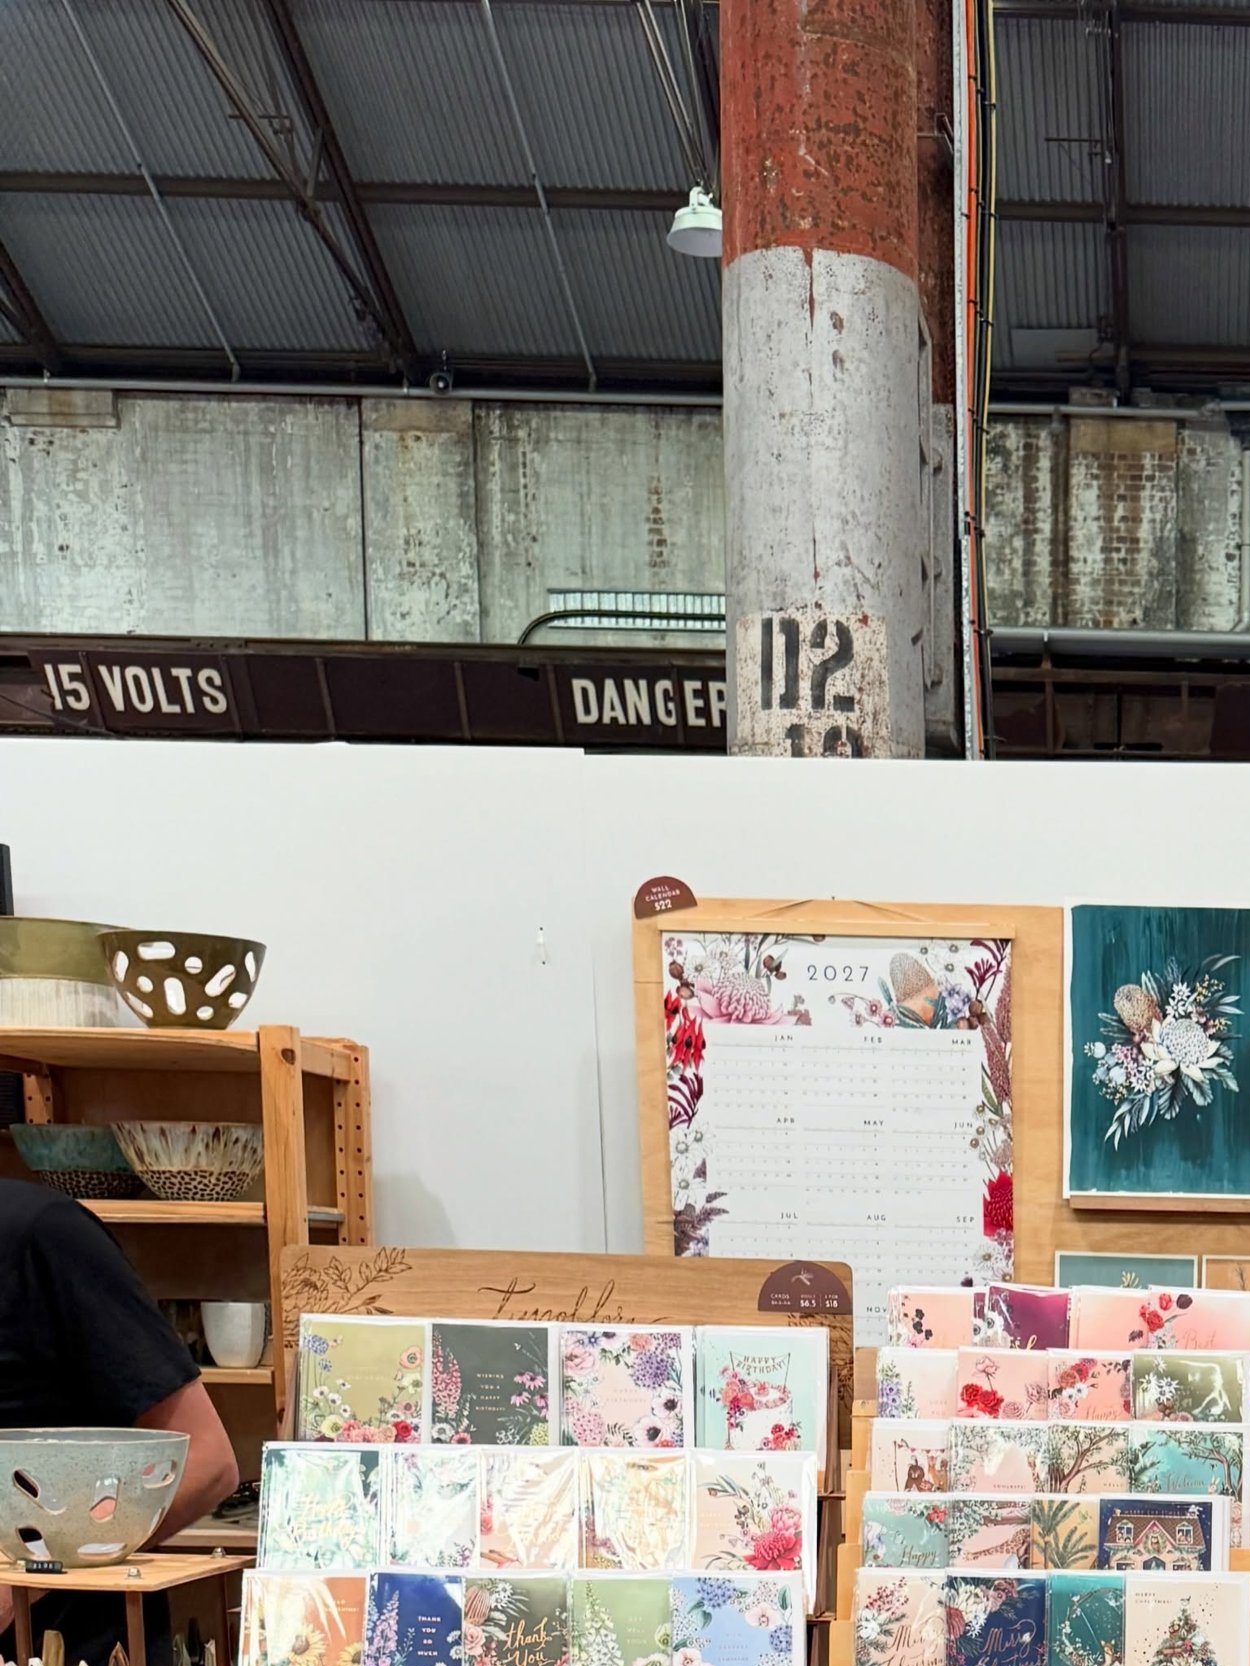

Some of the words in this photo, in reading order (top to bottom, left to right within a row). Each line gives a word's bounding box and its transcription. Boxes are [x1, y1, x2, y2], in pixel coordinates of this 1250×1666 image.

[97, 664, 228, 714] VOLTS
[571, 677, 727, 728] DANGER
[645, 888, 681, 902] CALENDAR
[654, 899, 673, 911] $22
[806, 965, 870, 982] 2027
[825, 1300, 838, 1308] $18
[735, 1360, 786, 1374] BIRTHDAY!
[743, 1356, 777, 1365] HAPPY
[502, 1616, 553, 1651] thank
